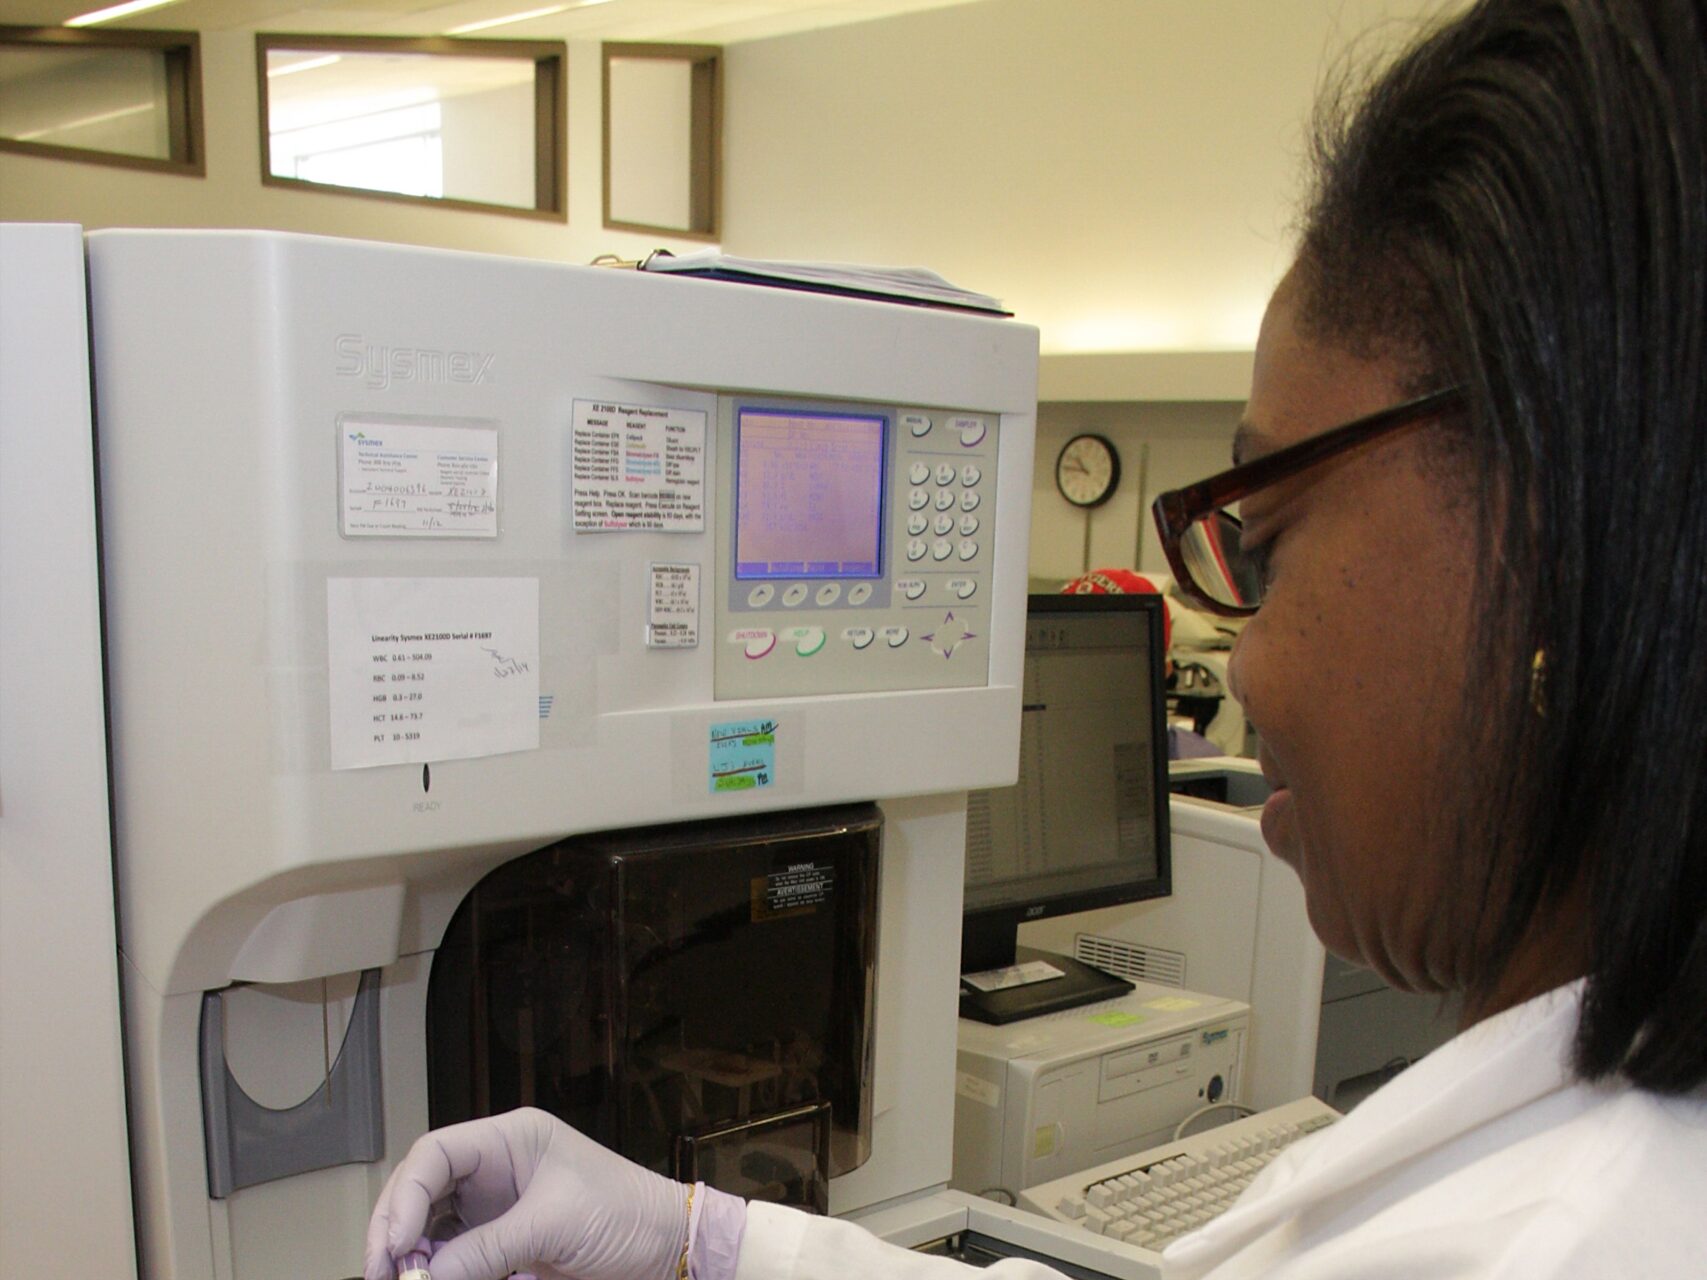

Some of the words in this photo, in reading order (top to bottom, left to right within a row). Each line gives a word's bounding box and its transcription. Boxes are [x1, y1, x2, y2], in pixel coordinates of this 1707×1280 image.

[335, 333, 497, 390] Sysmex
[618, 406, 637, 416] Reagent
[371, 633, 399, 644] Linearity
[400, 633, 423, 643] Sysmex
[424, 632, 451, 641] XE2100D
[452, 632, 469, 641] Serial
[735, 631, 768, 640] SHUTDOWN
[373, 654, 388, 663] WBC
[373, 674, 386, 683] RBC
[373, 694, 387, 703] HGB
[373, 714, 386, 723] HCT
[760, 720, 773, 735] AM
[373, 734, 385, 743] PLT
[787, 862, 815, 873] WARNING
[1026, 905, 1047, 917] acer
